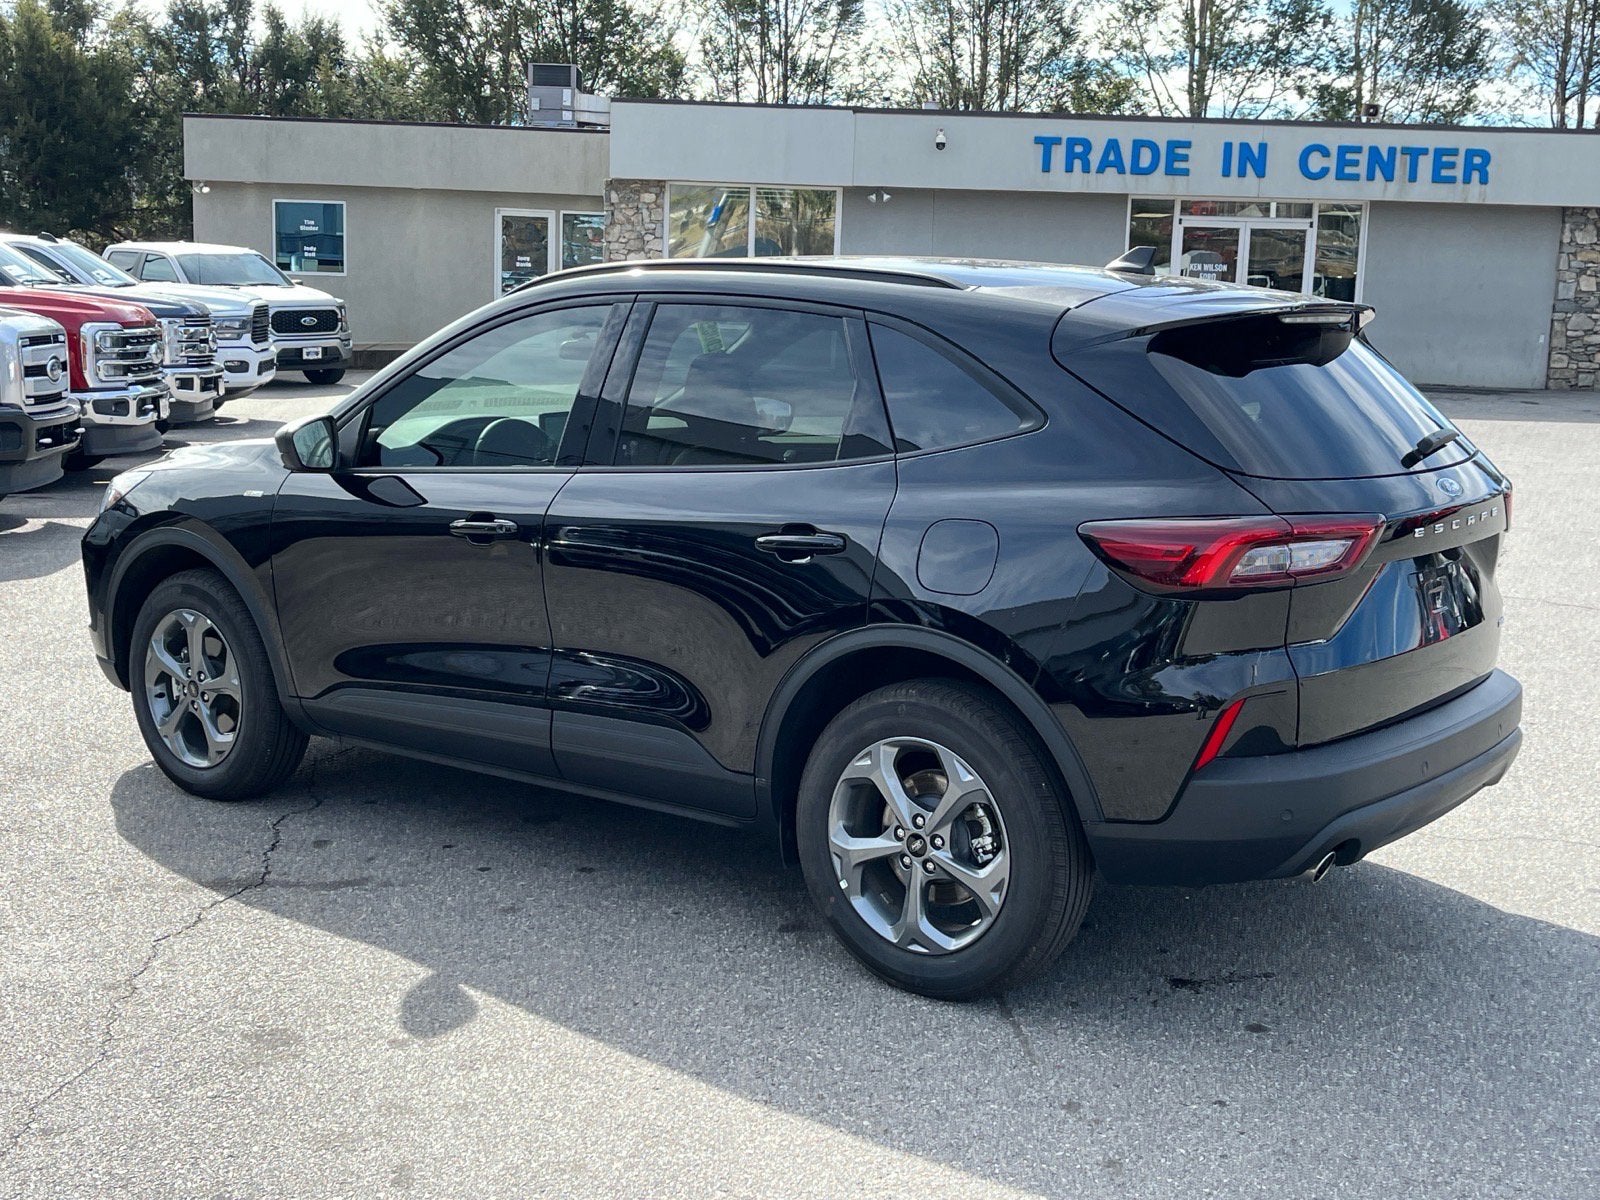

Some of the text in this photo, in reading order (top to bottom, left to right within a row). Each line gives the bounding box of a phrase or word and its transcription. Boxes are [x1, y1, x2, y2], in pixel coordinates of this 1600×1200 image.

[1033, 135, 1492, 185] TRADE IN CENTER
[1189, 263, 1228, 272] KEN WILSON
[1414, 506, 1499, 538] ESCAPE
